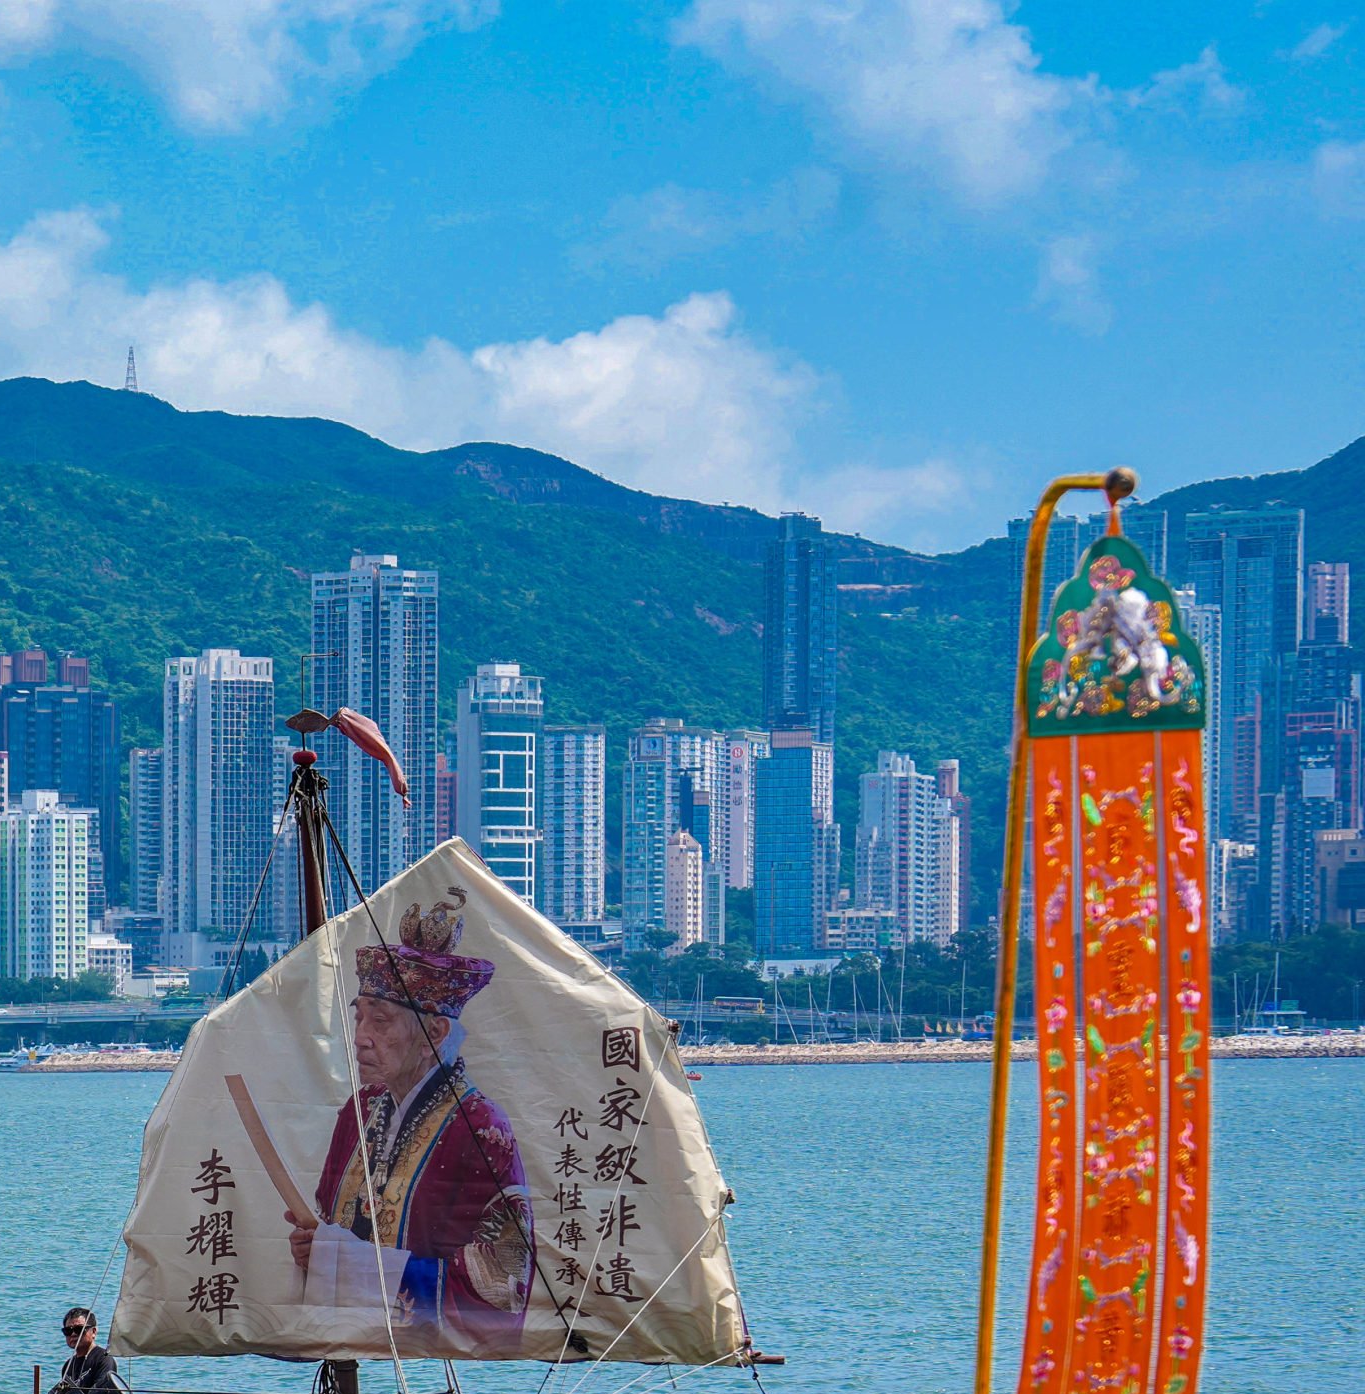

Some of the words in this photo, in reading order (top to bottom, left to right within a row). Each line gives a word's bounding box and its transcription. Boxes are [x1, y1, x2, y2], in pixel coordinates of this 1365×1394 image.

[185, 1148, 240, 1325] 李耀輝
[553, 1107, 591, 1318] 代表性傳承人
[593, 1026, 649, 1303] 國家級非遺
